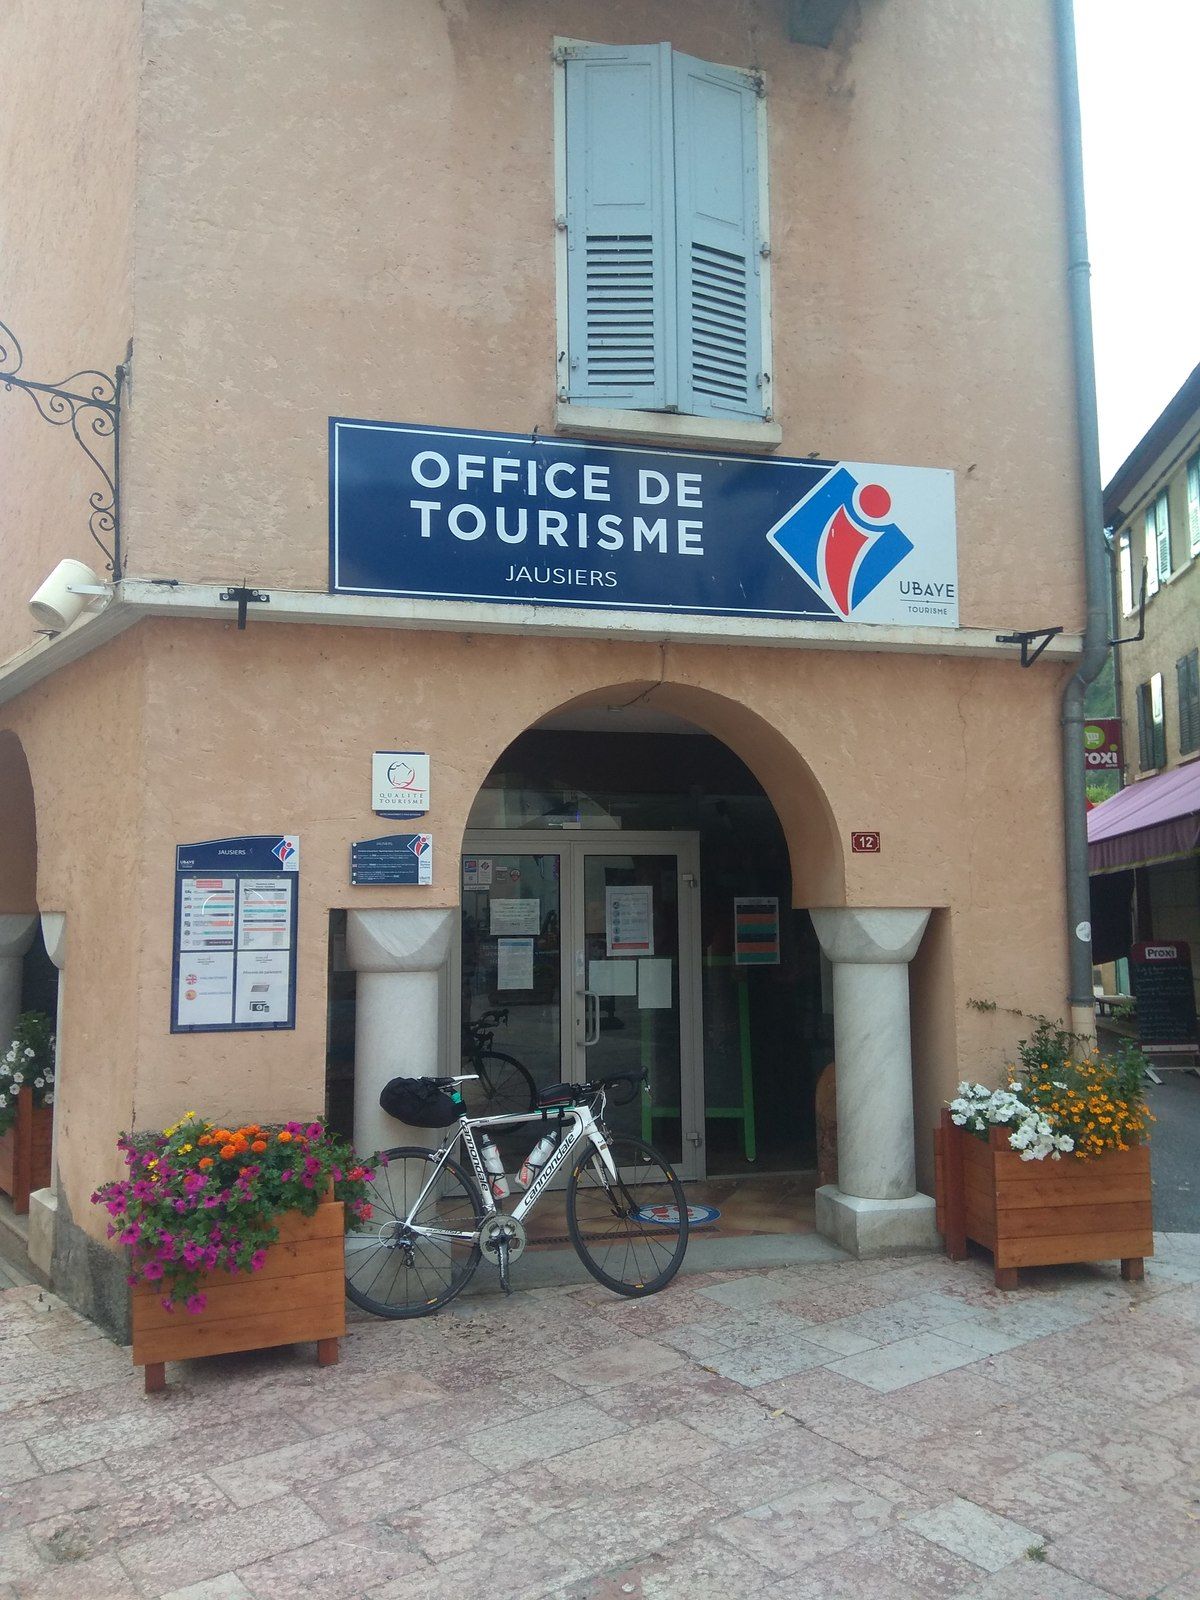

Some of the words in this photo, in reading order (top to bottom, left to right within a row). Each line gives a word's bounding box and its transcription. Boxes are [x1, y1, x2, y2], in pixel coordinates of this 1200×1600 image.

[411, 450, 611, 502] OFFICE
[638, 469, 703, 508] DE
[411, 500, 704, 555] TOURISME
[506, 565, 618, 587] JAUSIERS
[899, 580, 955, 598] UBAYE
[908, 606, 948, 616] TOURISME
[1084, 744, 1118, 765] roxi
[860, 836, 874, 848] 12
[1147, 947, 1175, 958] Proxi
[524, 1133, 575, 1207] cannondale
